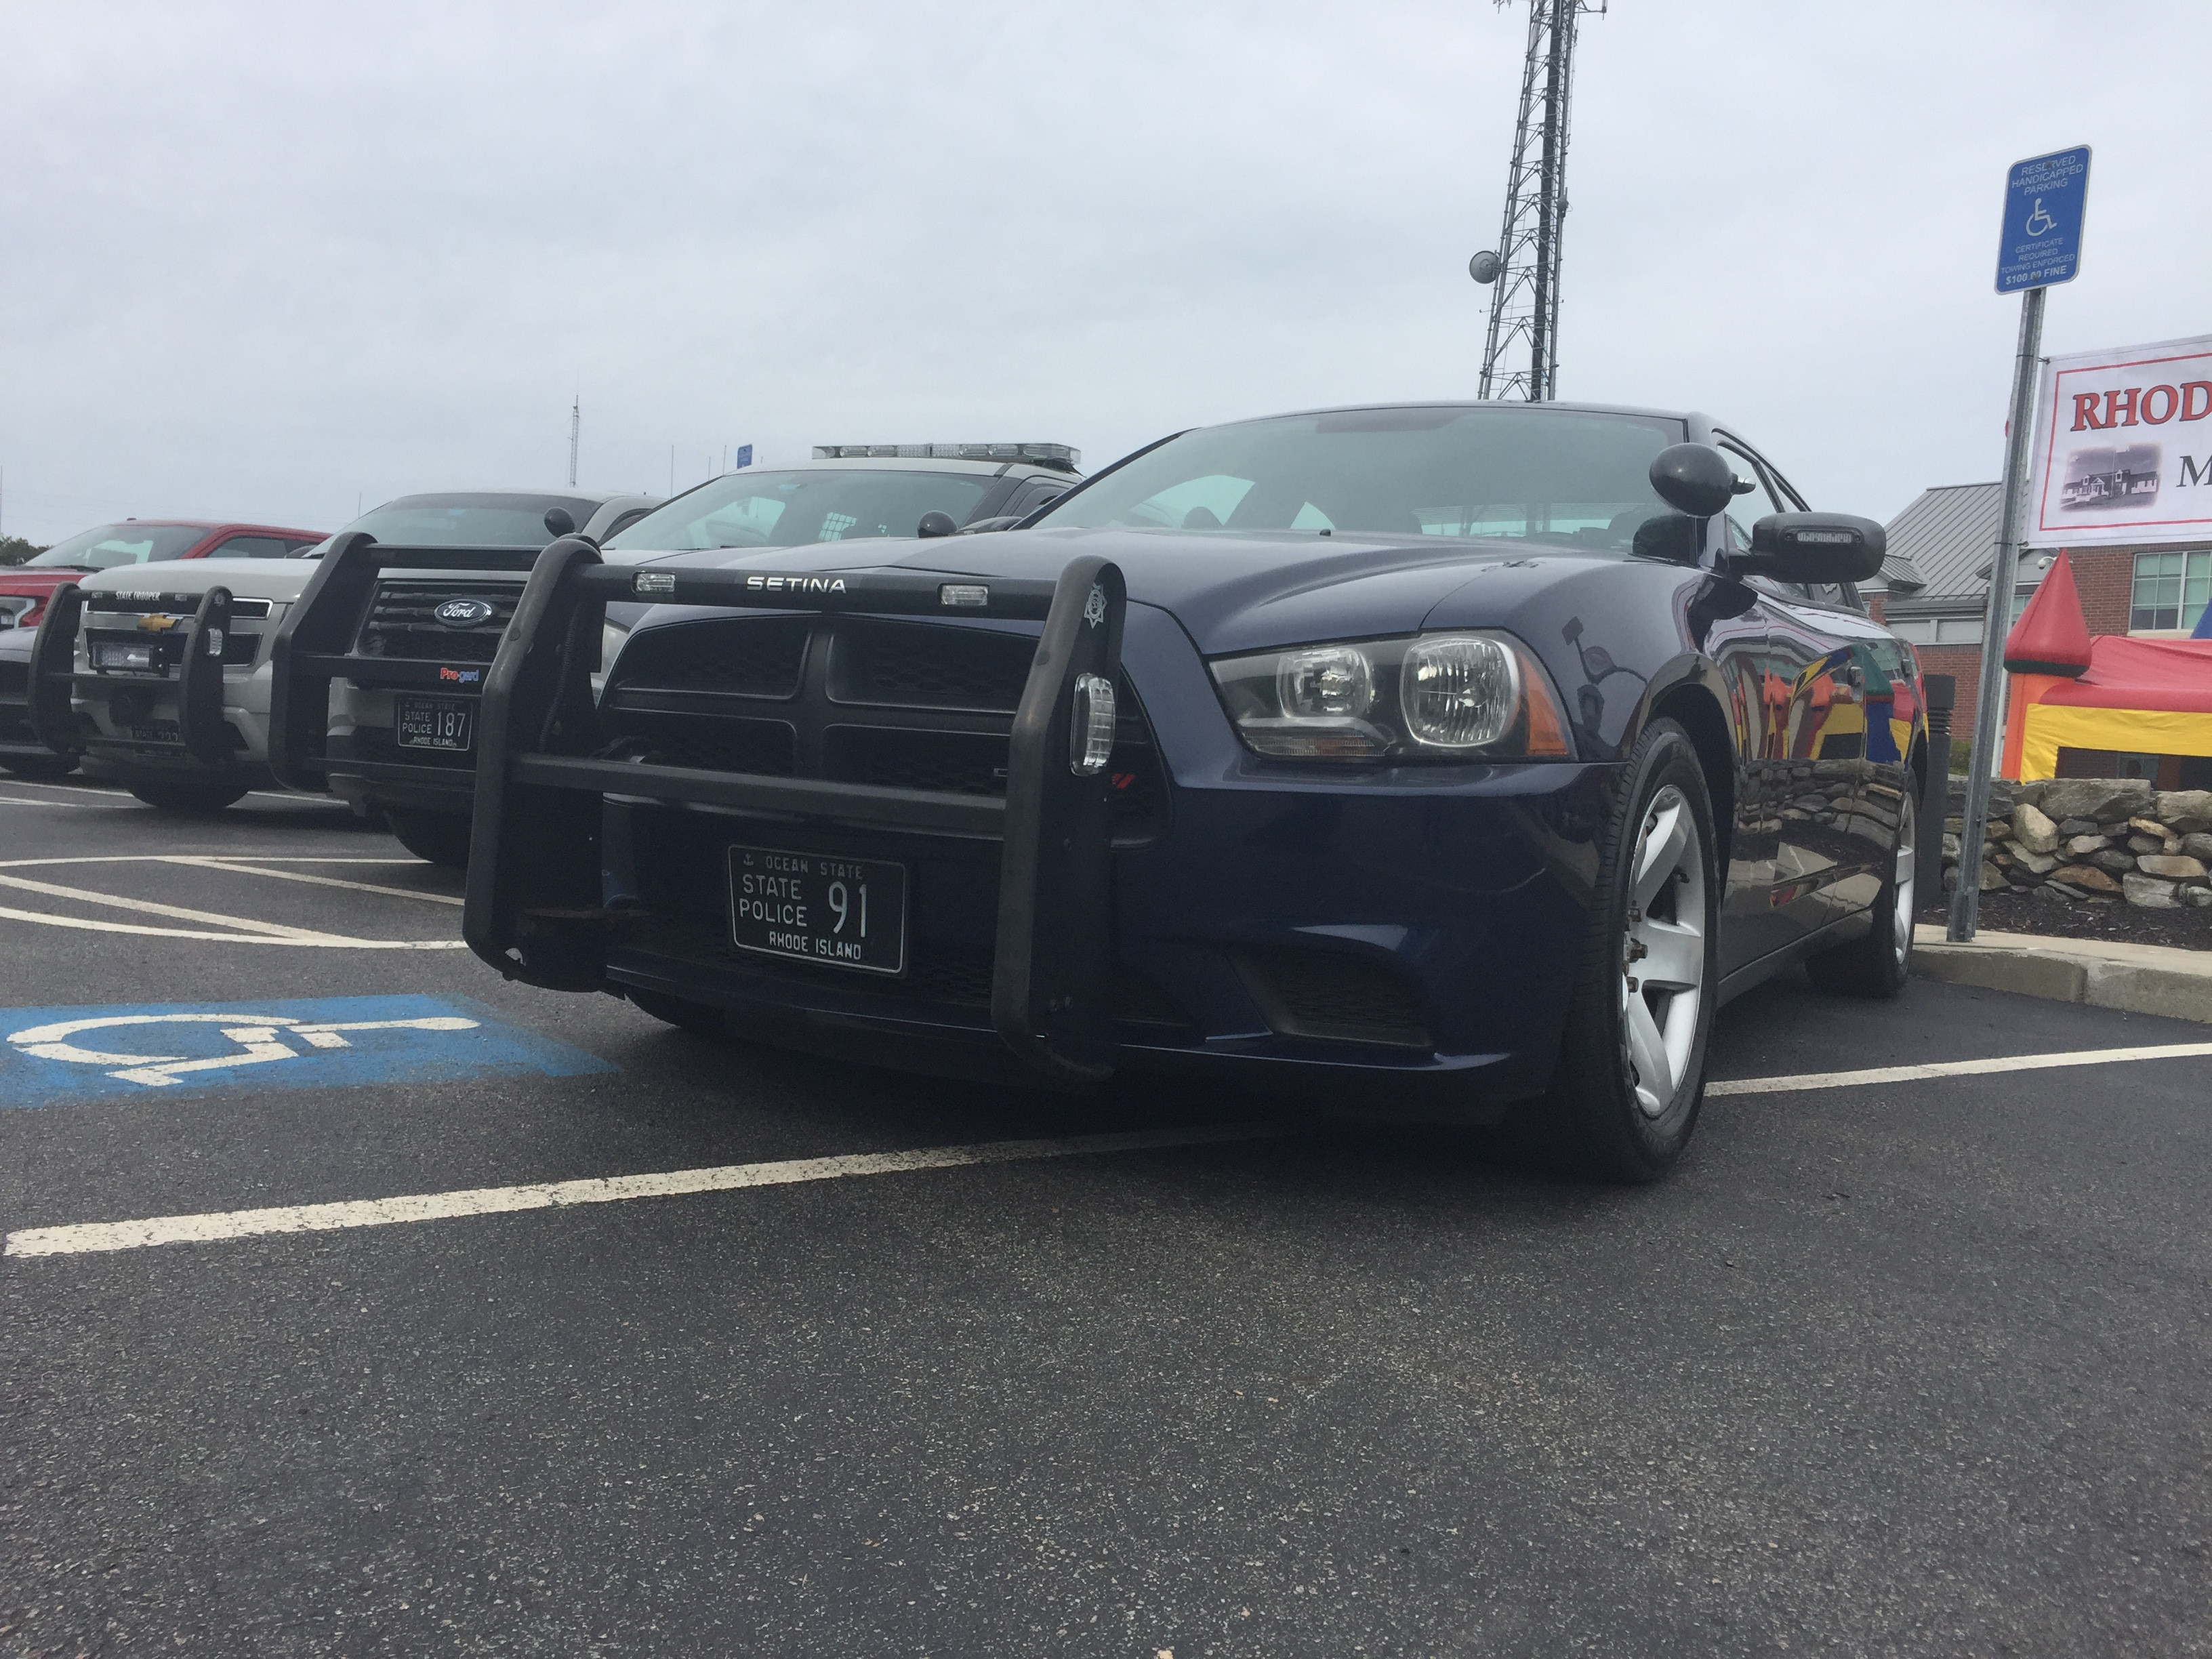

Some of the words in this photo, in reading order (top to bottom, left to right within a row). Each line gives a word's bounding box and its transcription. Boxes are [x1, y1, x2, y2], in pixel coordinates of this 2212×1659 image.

[2022, 155, 2076, 176] RESERVED
[2012, 163, 2084, 188] HANDICAPPED
[2024, 178, 2068, 196] PARKING
[2015, 237, 2064, 254] CERTIFICATE
[2018, 247, 2058, 262] REQUIRED
[2001, 262, 2030, 274] TOWING
[2032, 253, 2075, 268] ENFORCED
[2044, 265, 2068, 278] FINE
[2070, 380, 2212, 432] RHOD
[746, 576, 846, 594] SETINA
[115, 590, 133, 601] STATE
[133, 591, 161, 602] TROOPER
[443, 602, 476, 617] Ford
[405, 712, 430, 722] STATE
[437, 712, 466, 737] 187
[402, 722, 432, 734] POLICE
[413, 736, 430, 745] RHODE
[433, 737, 453, 747] ISLAND
[765, 855, 808, 874] OCEAN
[820, 861, 863, 880] STATE
[743, 874, 802, 901] STATE
[739, 898, 807, 927] POLICE
[828, 881, 867, 939] 91
[769, 930, 808, 953] RHODE
[815, 938, 861, 960] ISLAND
